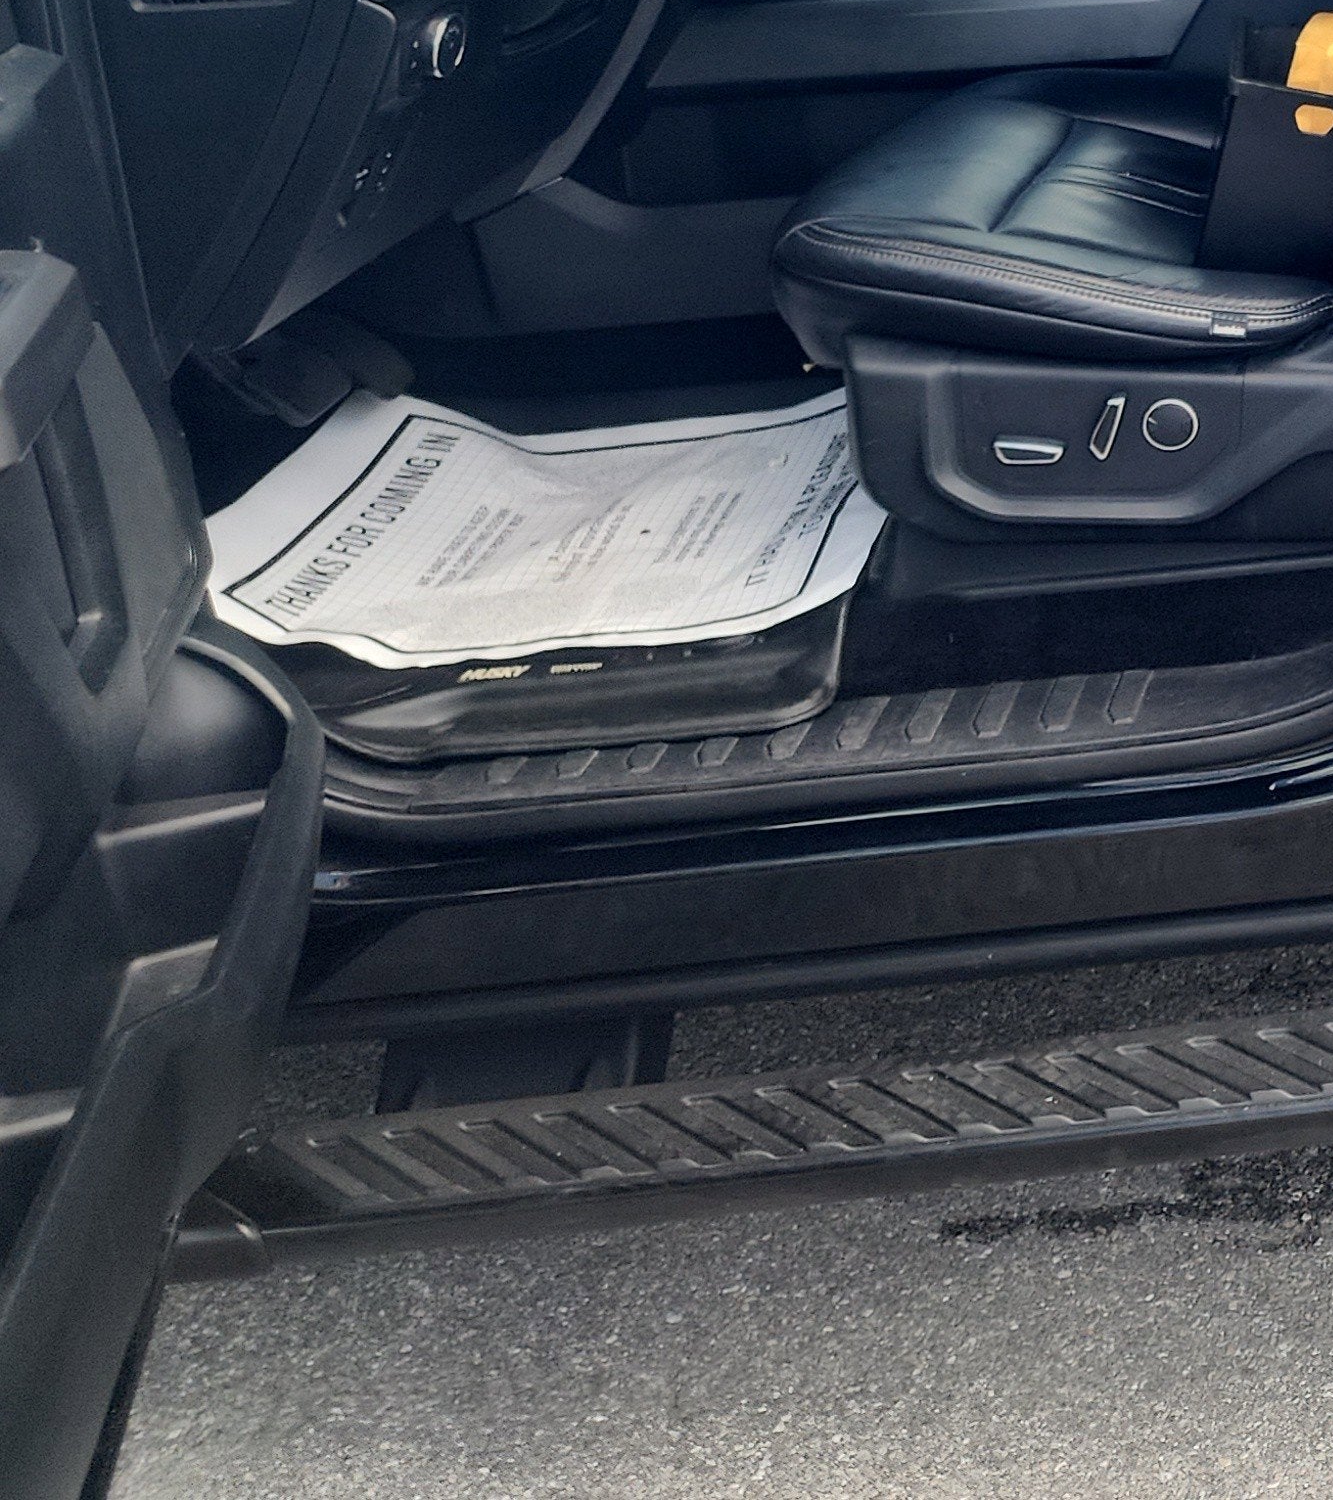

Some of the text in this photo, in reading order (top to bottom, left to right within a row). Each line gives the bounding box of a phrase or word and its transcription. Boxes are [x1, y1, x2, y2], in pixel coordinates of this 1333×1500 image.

[265, 557, 351, 616] THANKS
[326, 524, 385, 558] FOR
[360, 457, 443, 524] COMING
